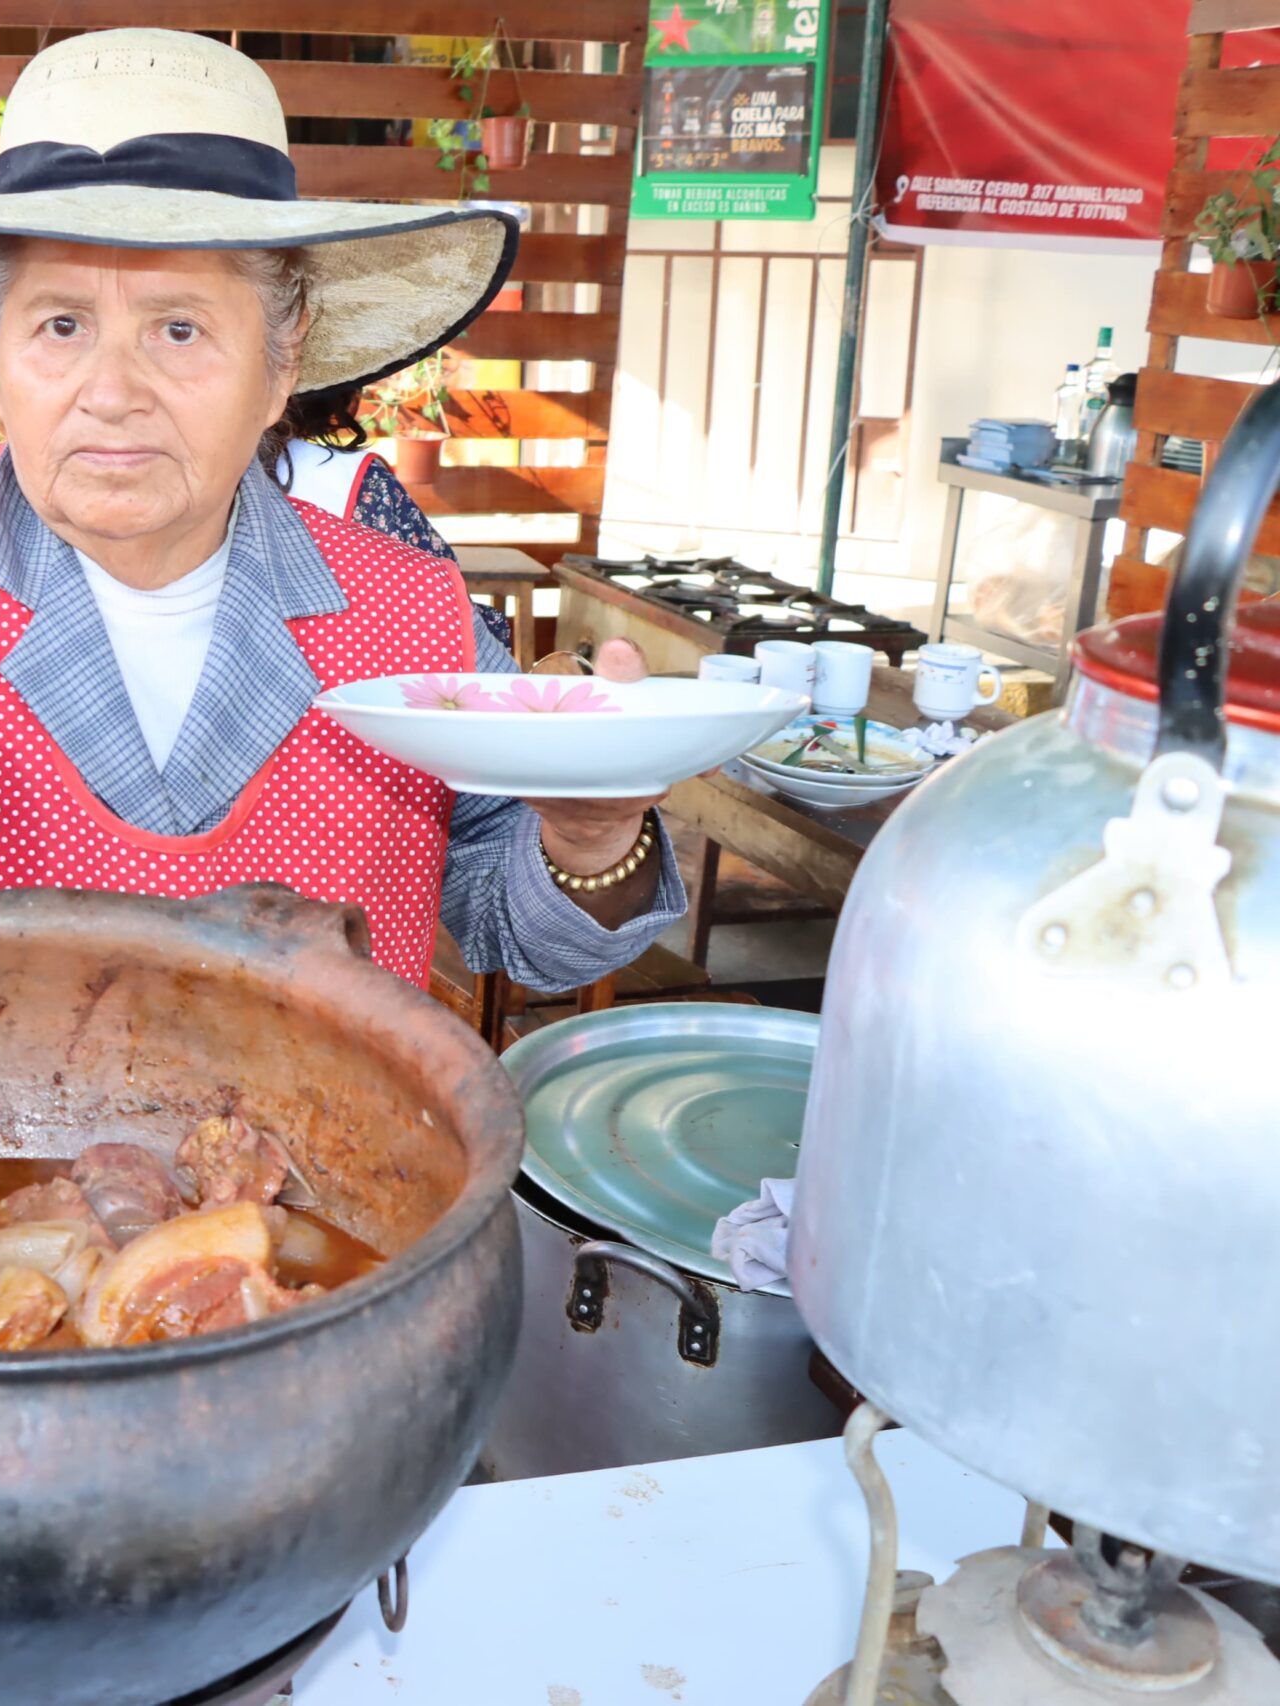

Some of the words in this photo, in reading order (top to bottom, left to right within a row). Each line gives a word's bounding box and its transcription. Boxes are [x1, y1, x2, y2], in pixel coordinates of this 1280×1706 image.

[751, 91, 777, 106] UNA
[731, 107, 772, 122] CHELA
[773, 106, 805, 121] PARA
[730, 123, 753, 138] LOS
[653, 188, 682, 200] TOMAR
[685, 188, 723, 200] BEBIDAS
[933, 177, 985, 195] SANCHEZ
[985, 180, 1029, 198] CERRO
[1031, 183, 1055, 201] 317
[1053, 185, 1103, 203] MANUEL
[1103, 187, 1144, 204] PRADO
[667, 201, 680, 213] EN
[682, 201, 716, 213] EXCESO
[719, 201, 730, 213] ES
[916, 193, 981, 213] (REFERENCIA
[981, 197, 998, 214] AL
[999, 199, 1058, 217] COSTADO
[1057, 202, 1077, 219] DE
[1076, 203, 1128, 222] TOTTUS)
